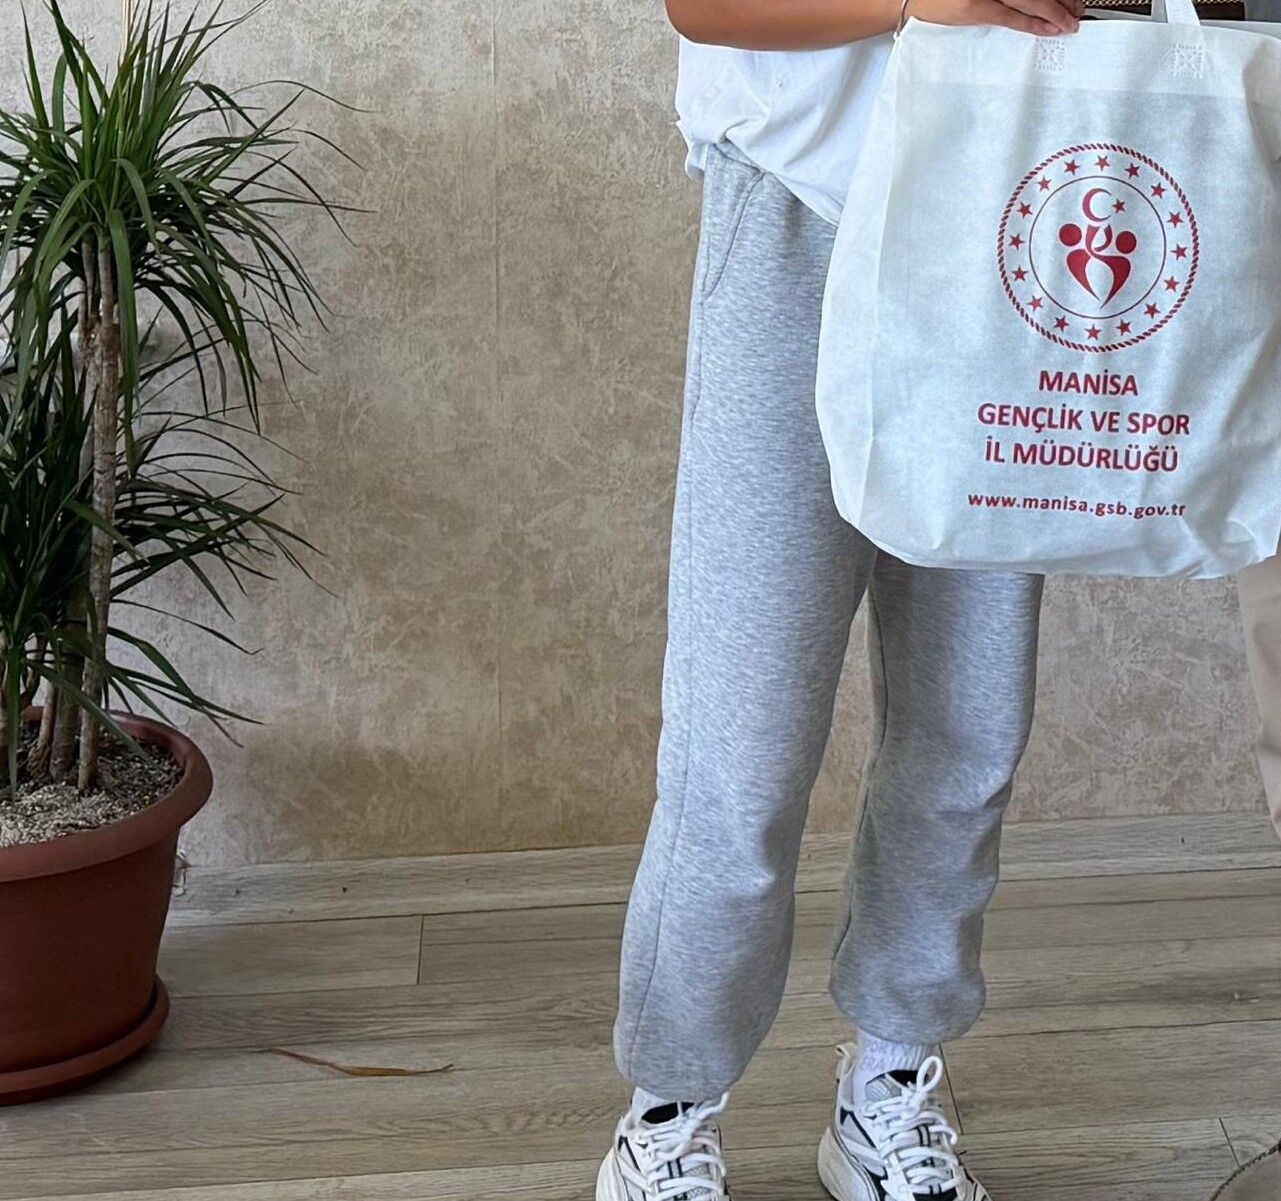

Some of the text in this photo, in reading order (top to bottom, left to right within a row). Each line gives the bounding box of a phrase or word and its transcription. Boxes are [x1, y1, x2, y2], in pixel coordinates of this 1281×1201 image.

[1039, 369, 1139, 396] MANİSA
[977, 402, 1190, 436] GENÇLİK VE SPOR
[984, 435, 1179, 473] İL MÜDÜRLÜĞÜ
[967, 492, 1187, 520] www.manisa.gsb.gov.tr
